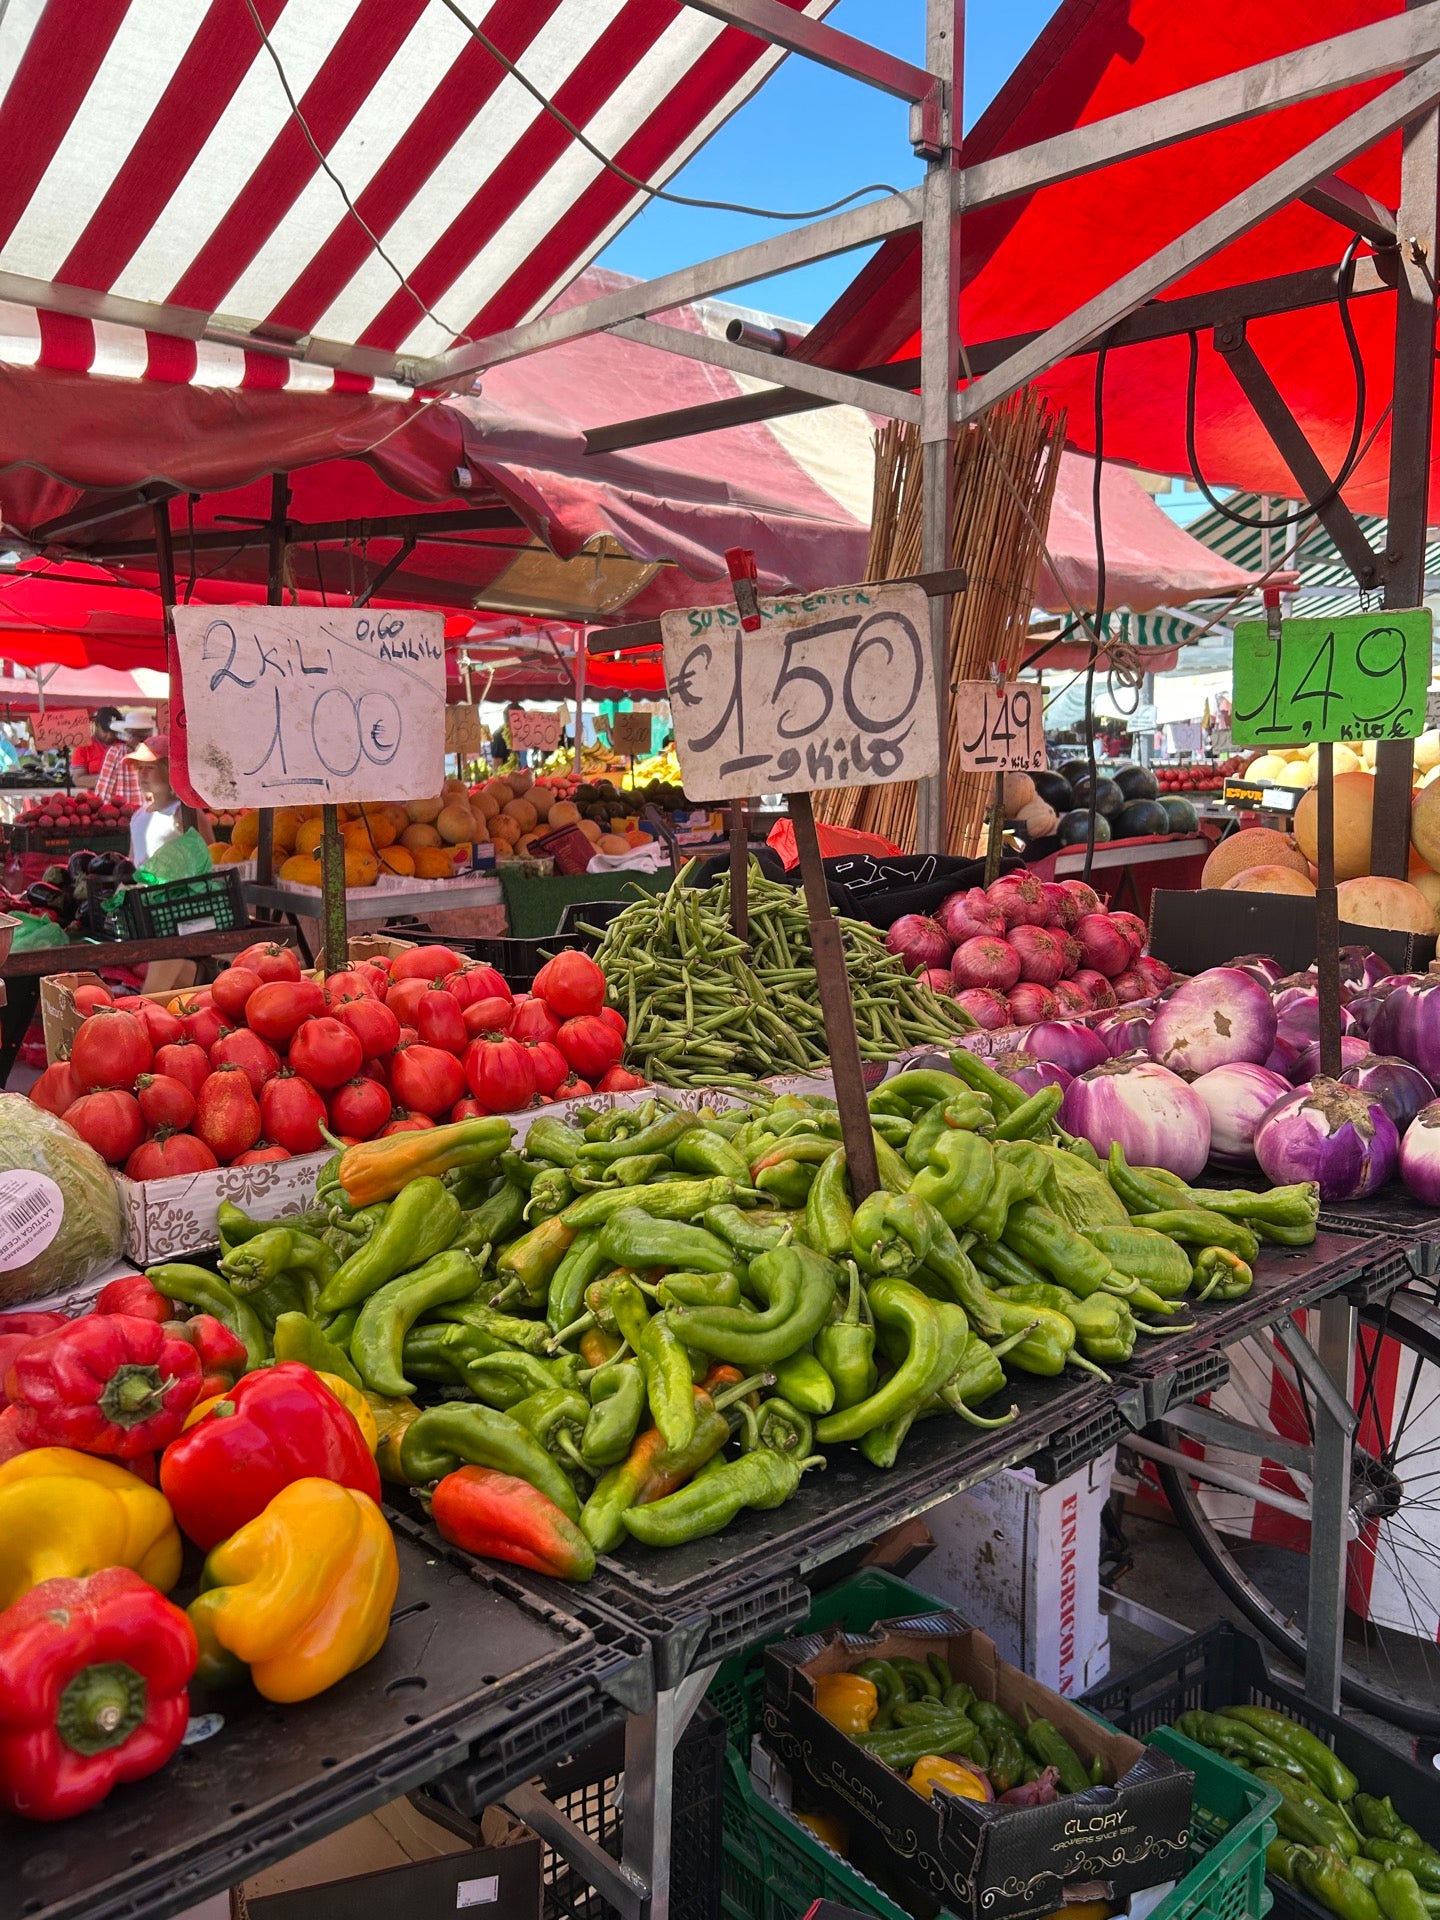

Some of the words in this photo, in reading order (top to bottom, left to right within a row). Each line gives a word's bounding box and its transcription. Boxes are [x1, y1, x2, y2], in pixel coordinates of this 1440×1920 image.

[355, 612, 405, 643] 0,60
[201, 619, 256, 692] 2
[21, 1208, 55, 1237] LATTUGA
[831, 1760, 884, 1810] GLORY
[1064, 1809, 1128, 1835] GLORY
